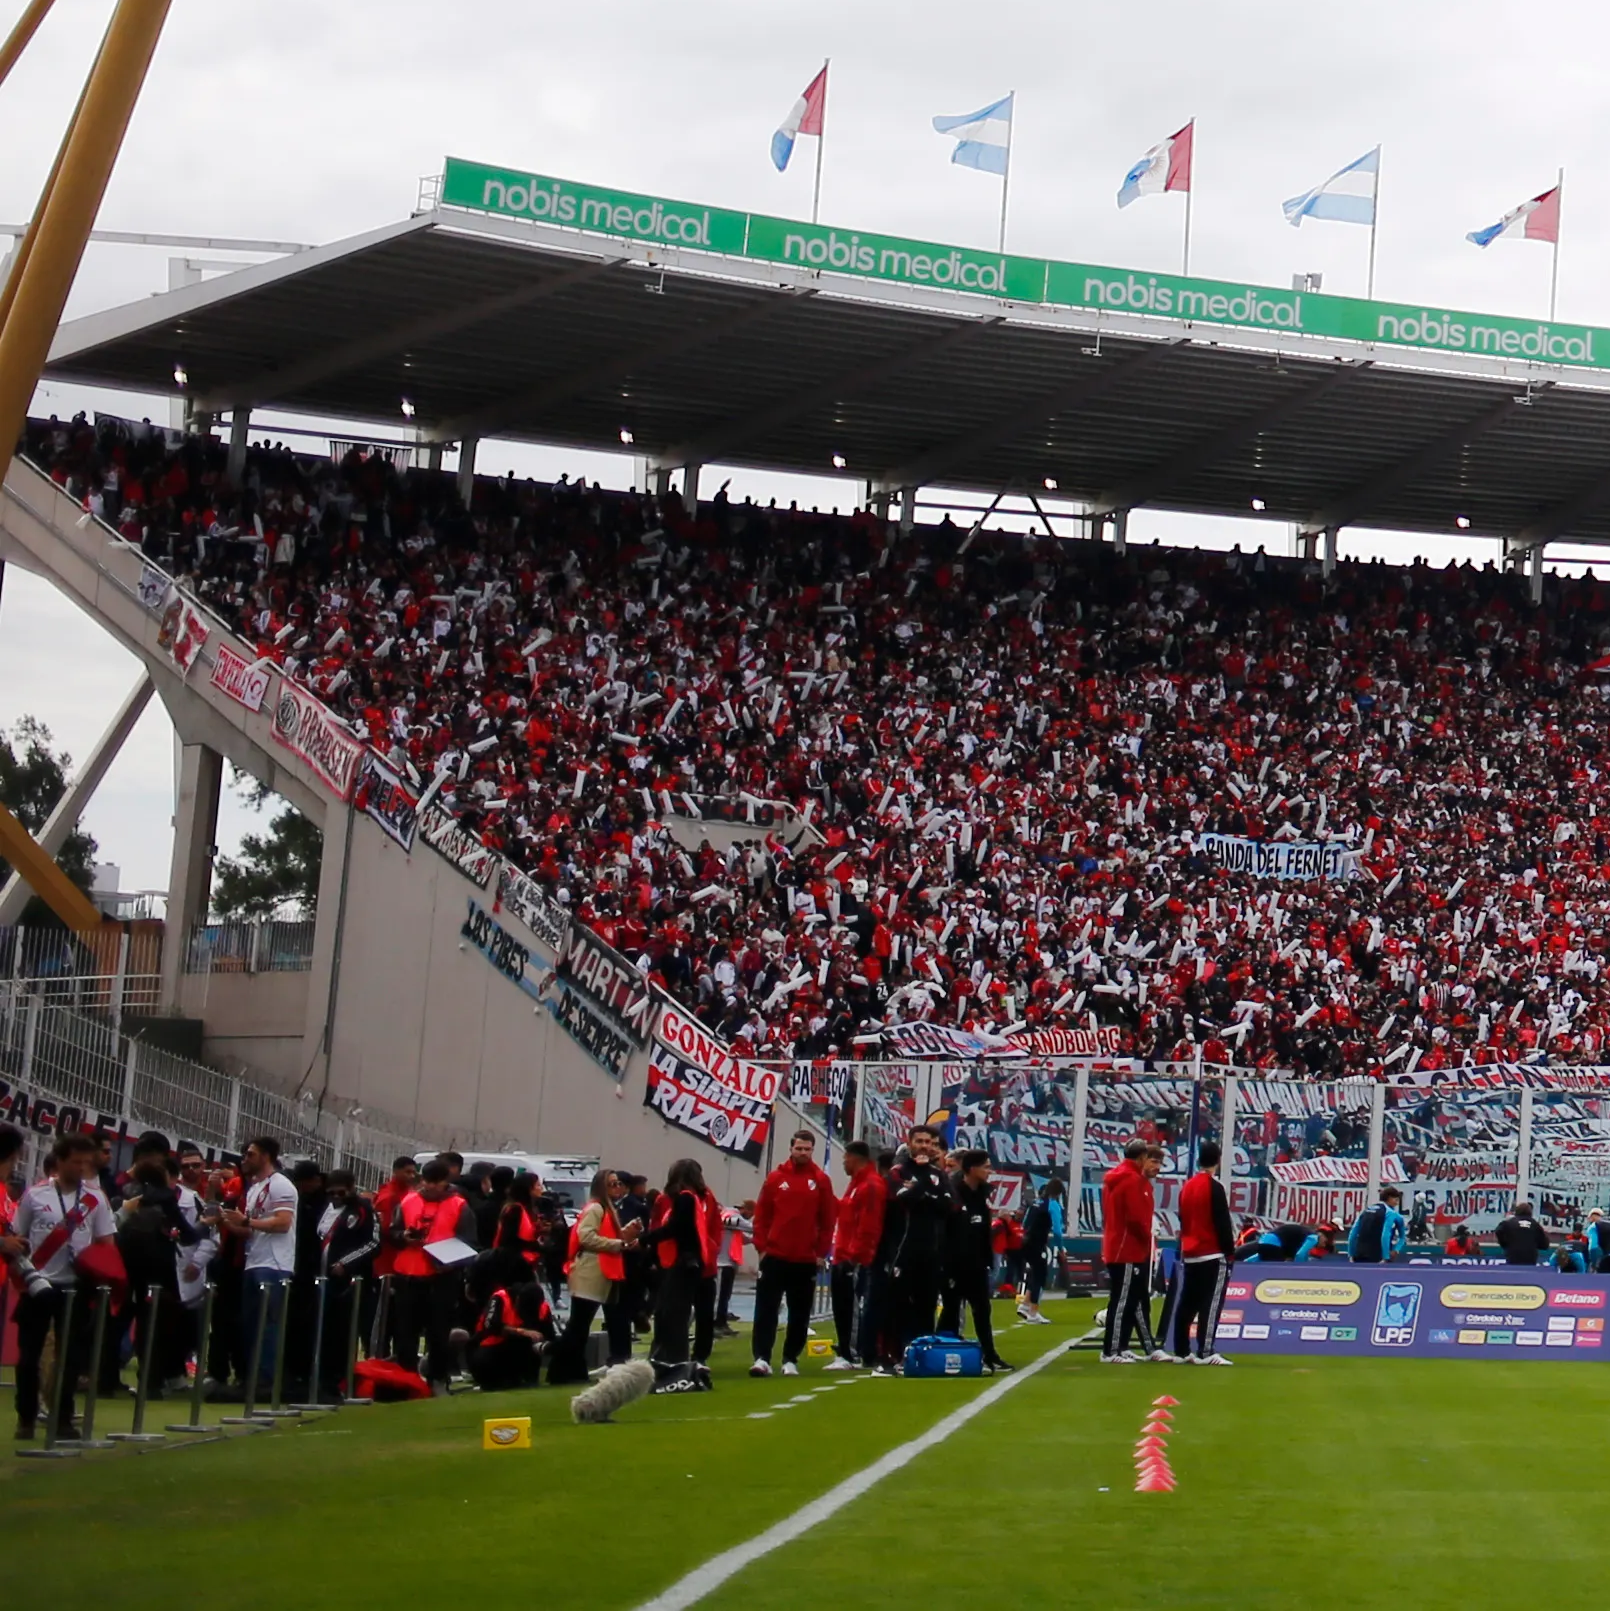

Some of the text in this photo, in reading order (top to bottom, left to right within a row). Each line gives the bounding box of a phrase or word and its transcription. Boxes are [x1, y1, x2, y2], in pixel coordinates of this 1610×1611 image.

[482, 178, 712, 246] nobis medical
[783, 231, 1007, 292] nobis medical
[1084, 276, 1303, 329] nobis medical
[1377, 311, 1595, 363] nobis medical
[1257, 848, 1282, 875] DEL
[1286, 848, 1341, 876] FERNET
[662, 1011, 777, 1102] GONZALO
[650, 1044, 770, 1123] LA SIMPLE
[791, 1065, 847, 1101] PACHECO
[1274, 1158, 1333, 1182] FAMILIA
[1285, 1287, 1353, 1297] mercado libre
[1470, 1292, 1538, 1301] mercado libre
[1554, 1292, 1600, 1304] Betano
[1281, 1309, 1319, 1319] Córdoba
[1466, 1313, 1503, 1323] Córdoba
[1373, 1327, 1413, 1343] LPF
